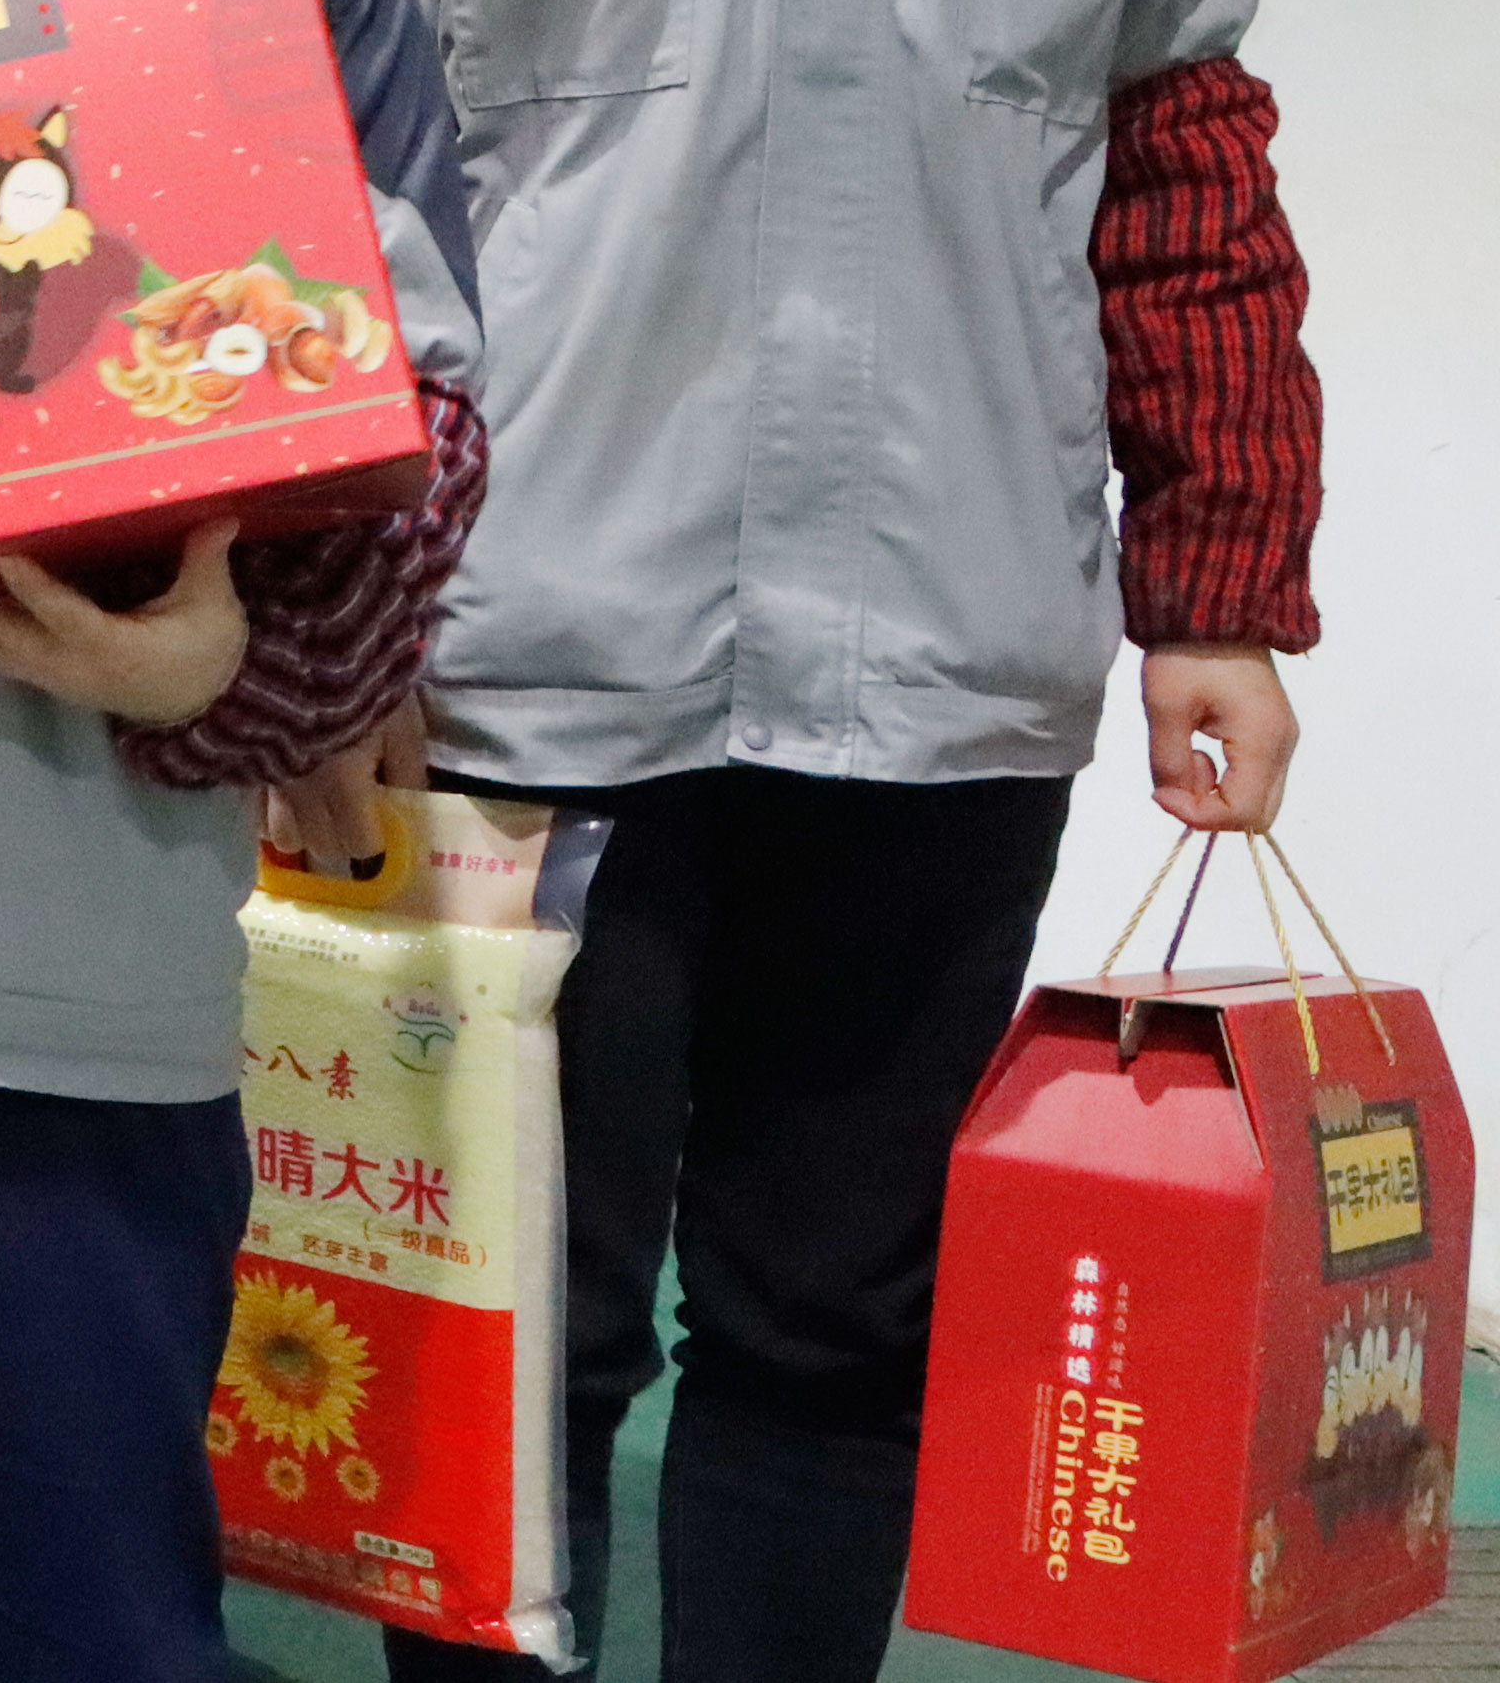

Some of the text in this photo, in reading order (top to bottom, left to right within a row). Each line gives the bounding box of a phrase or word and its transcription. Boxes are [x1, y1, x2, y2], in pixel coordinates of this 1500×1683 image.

[244, 1045, 362, 1102] 八素
[1326, 1155, 1420, 1227] 干果大礼包
[1066, 1254, 1100, 1385] 森林精选
[1045, 1388, 1087, 1582] Chinese
[1083, 1395, 1145, 1566] 干果大礼包
